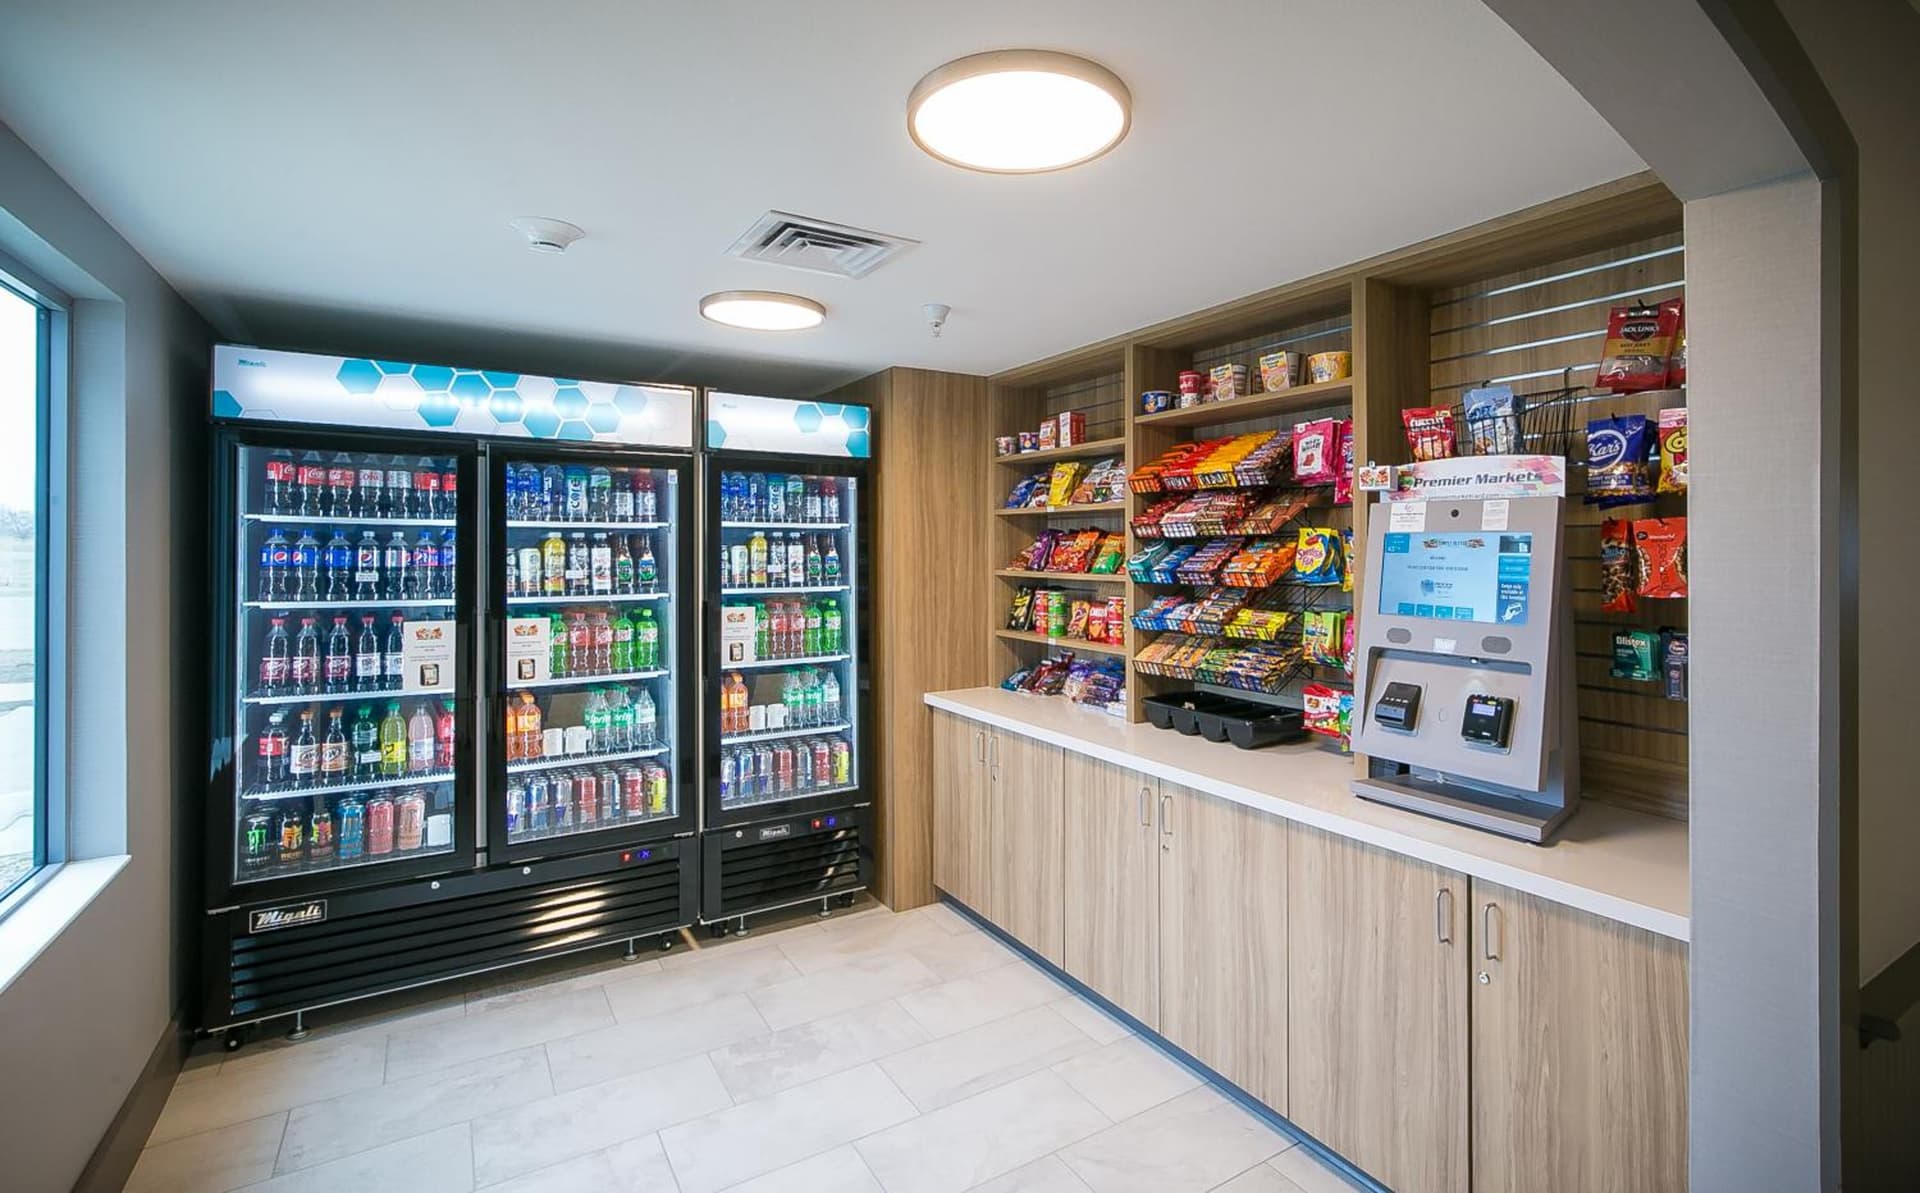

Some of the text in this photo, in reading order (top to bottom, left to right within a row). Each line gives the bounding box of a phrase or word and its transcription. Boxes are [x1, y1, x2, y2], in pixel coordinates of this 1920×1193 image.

[1588, 440, 1621, 457] Kar's
[1414, 470, 1543, 488] Premier Markets
[1616, 636, 1647, 649] Blistex
[256, 904, 322, 927] Migali
